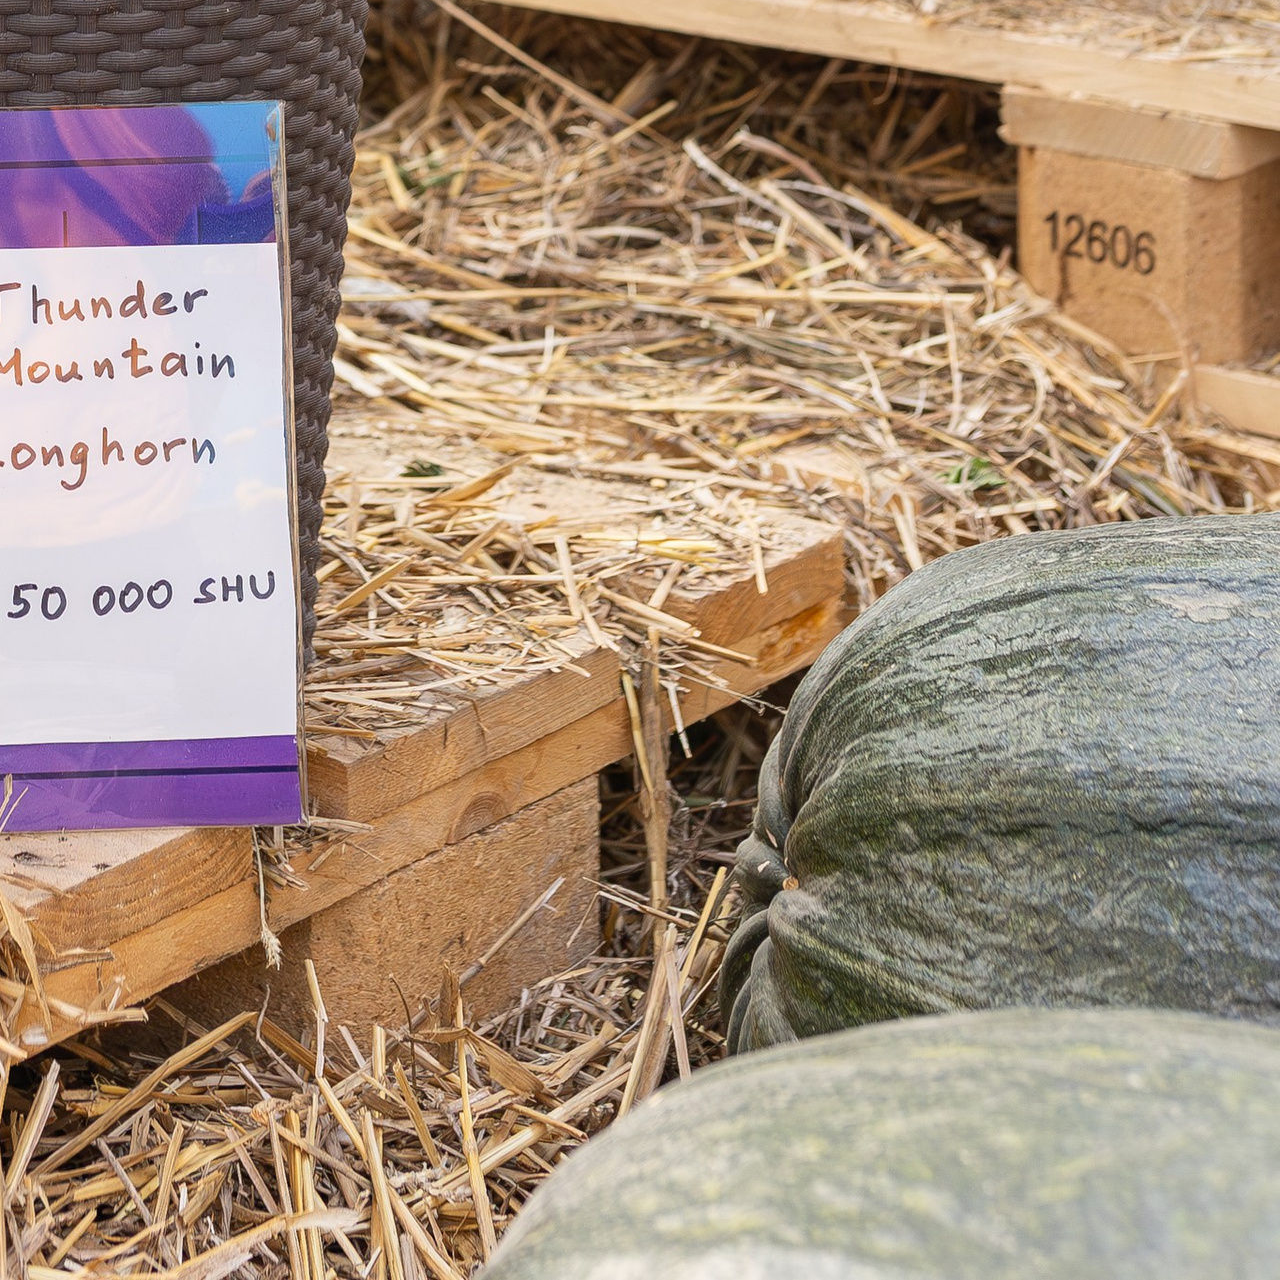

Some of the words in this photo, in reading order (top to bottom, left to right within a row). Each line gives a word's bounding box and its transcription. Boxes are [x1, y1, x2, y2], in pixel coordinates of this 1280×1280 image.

[1044, 210, 1156, 276] 12606
[7, 581, 67, 621] 50
[92, 577, 173, 614] 000
[193, 570, 278, 605] SHU
